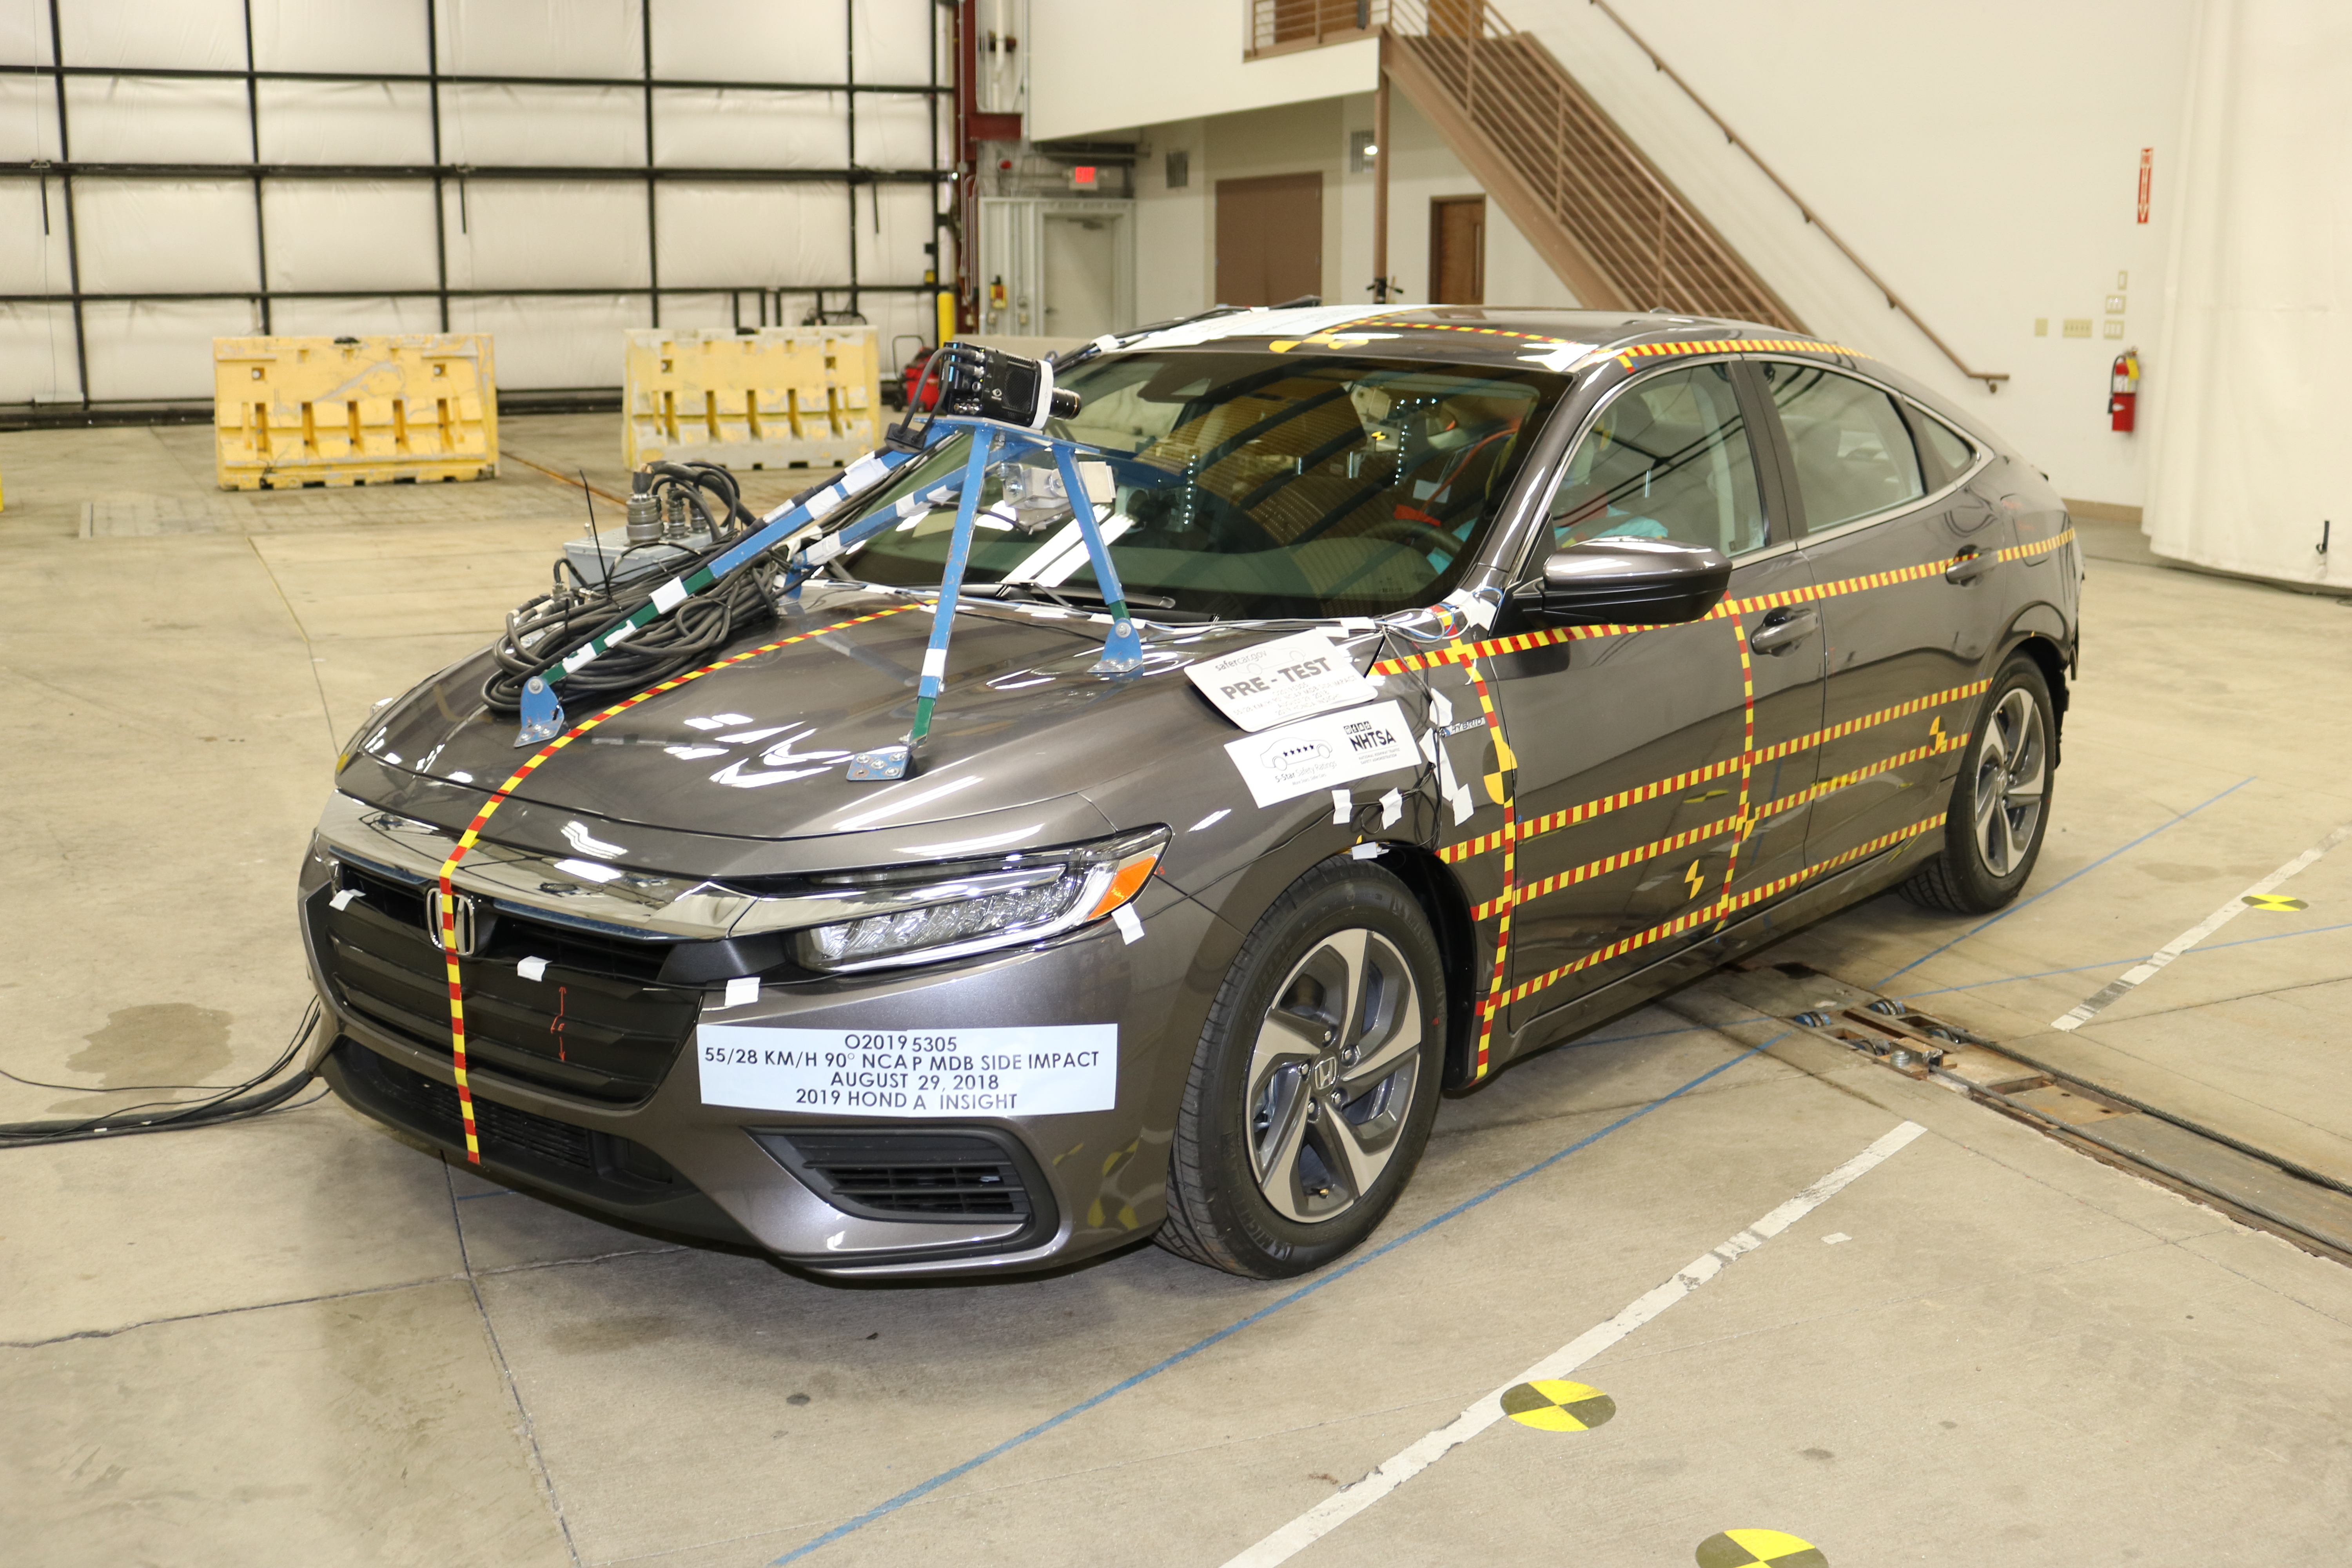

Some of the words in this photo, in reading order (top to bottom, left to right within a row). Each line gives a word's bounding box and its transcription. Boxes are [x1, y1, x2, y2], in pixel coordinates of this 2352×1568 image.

[1215, 650, 1267, 671] safercar.gov
[1220, 677, 1270, 699] PRE
[1277, 657, 1331, 682] TEST
[1452, 718, 1482, 734] HYBRID
[1349, 729, 1396, 751] NHTSA
[1275, 773, 1295, 782] 5-Star
[1296, 766, 1314, 777] Safety
[1314, 760, 1337, 771] Ratings
[705, 1047, 758, 1065] 55/28
[764, 1051, 818, 1068] KM/H
[825, 1051, 856, 1068] 90°
[930, 1054, 975, 1071] MDB
[981, 1053, 1022, 1071] SIDE
[1029, 1051, 1099, 1069] IMPACT
[831, 1072, 909, 1088] AUGUST
[918, 1074, 946, 1093] 29,
[953, 1075, 998, 1090] 2018
[796, 1089, 840, 1105] 2019
[940, 1093, 1017, 1110] INSIGHT
